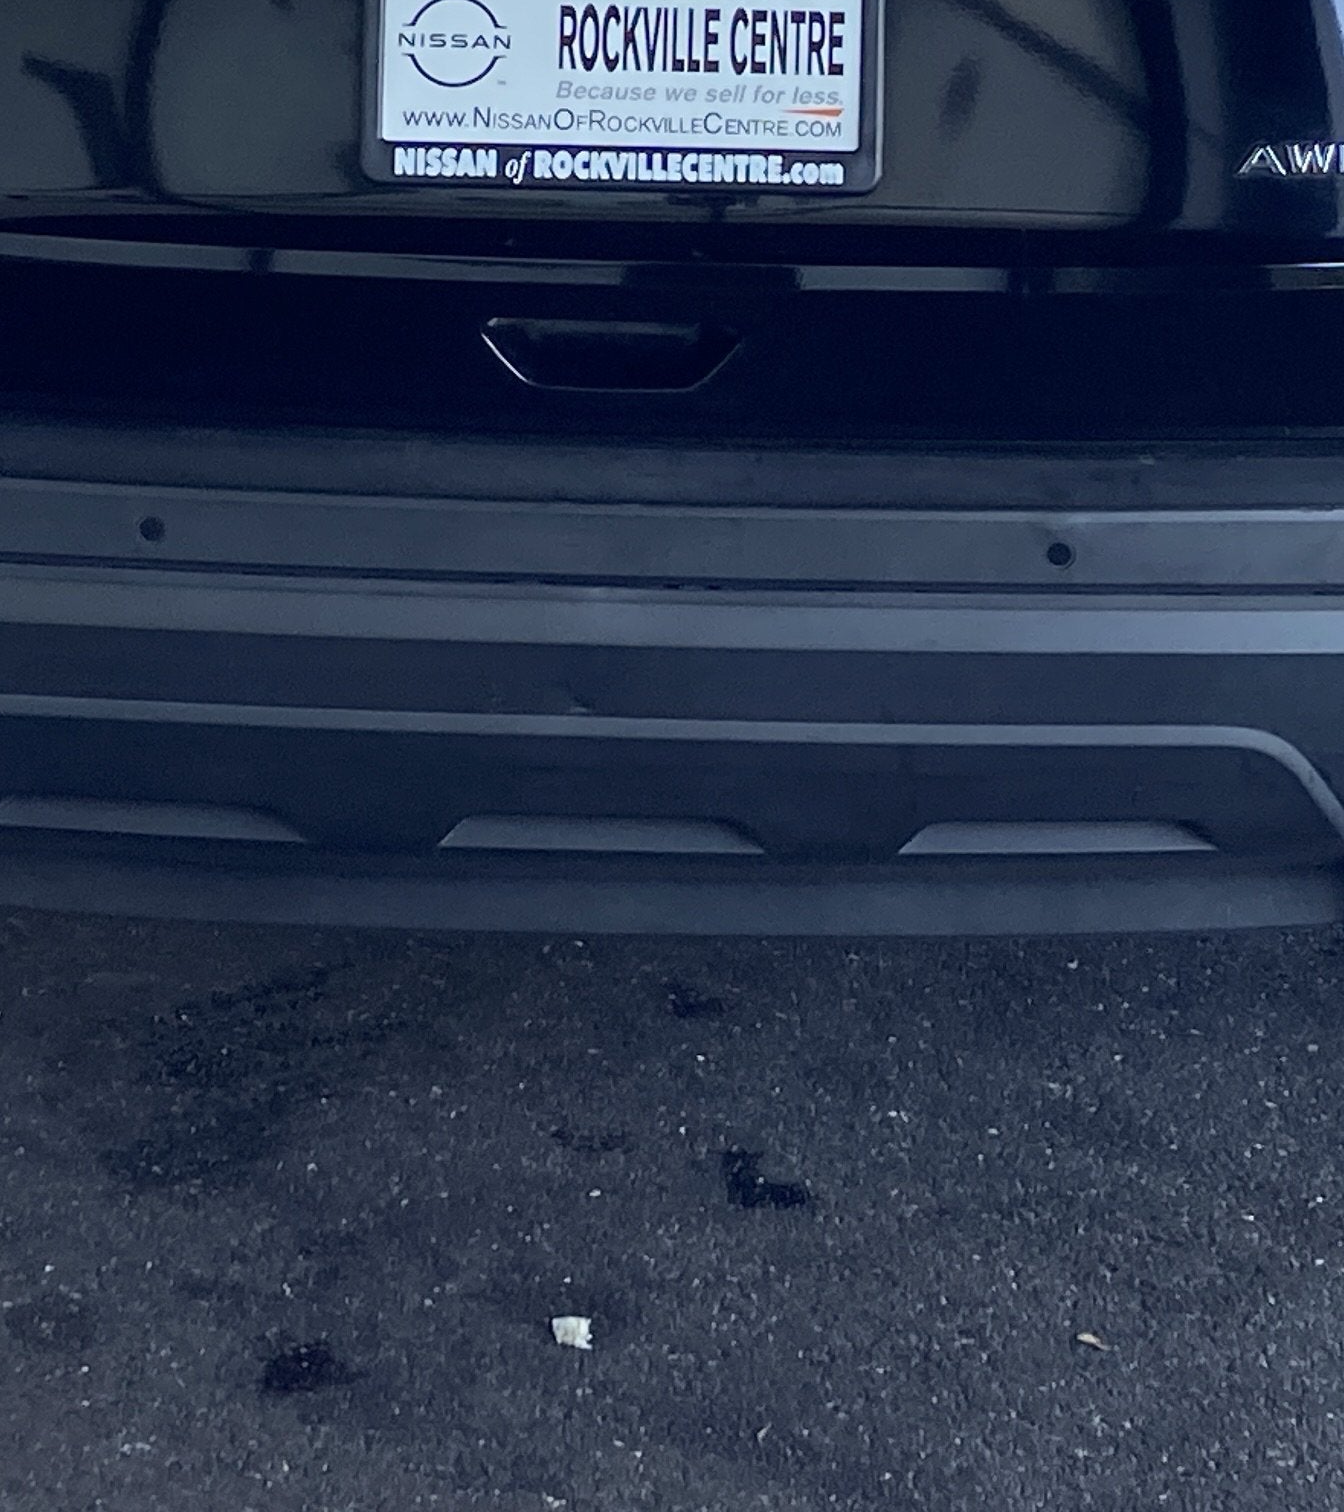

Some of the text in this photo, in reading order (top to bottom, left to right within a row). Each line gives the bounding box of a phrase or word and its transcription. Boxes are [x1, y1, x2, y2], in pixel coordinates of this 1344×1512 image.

[398, 33, 512, 50] NISSAN
[558, 3, 846, 76] ROCKVILLE CENTRE
[556, 80, 844, 106] Because we sell for less.
[393, 147, 845, 185] NISSAN of ROCKVILLECENTRE.com
